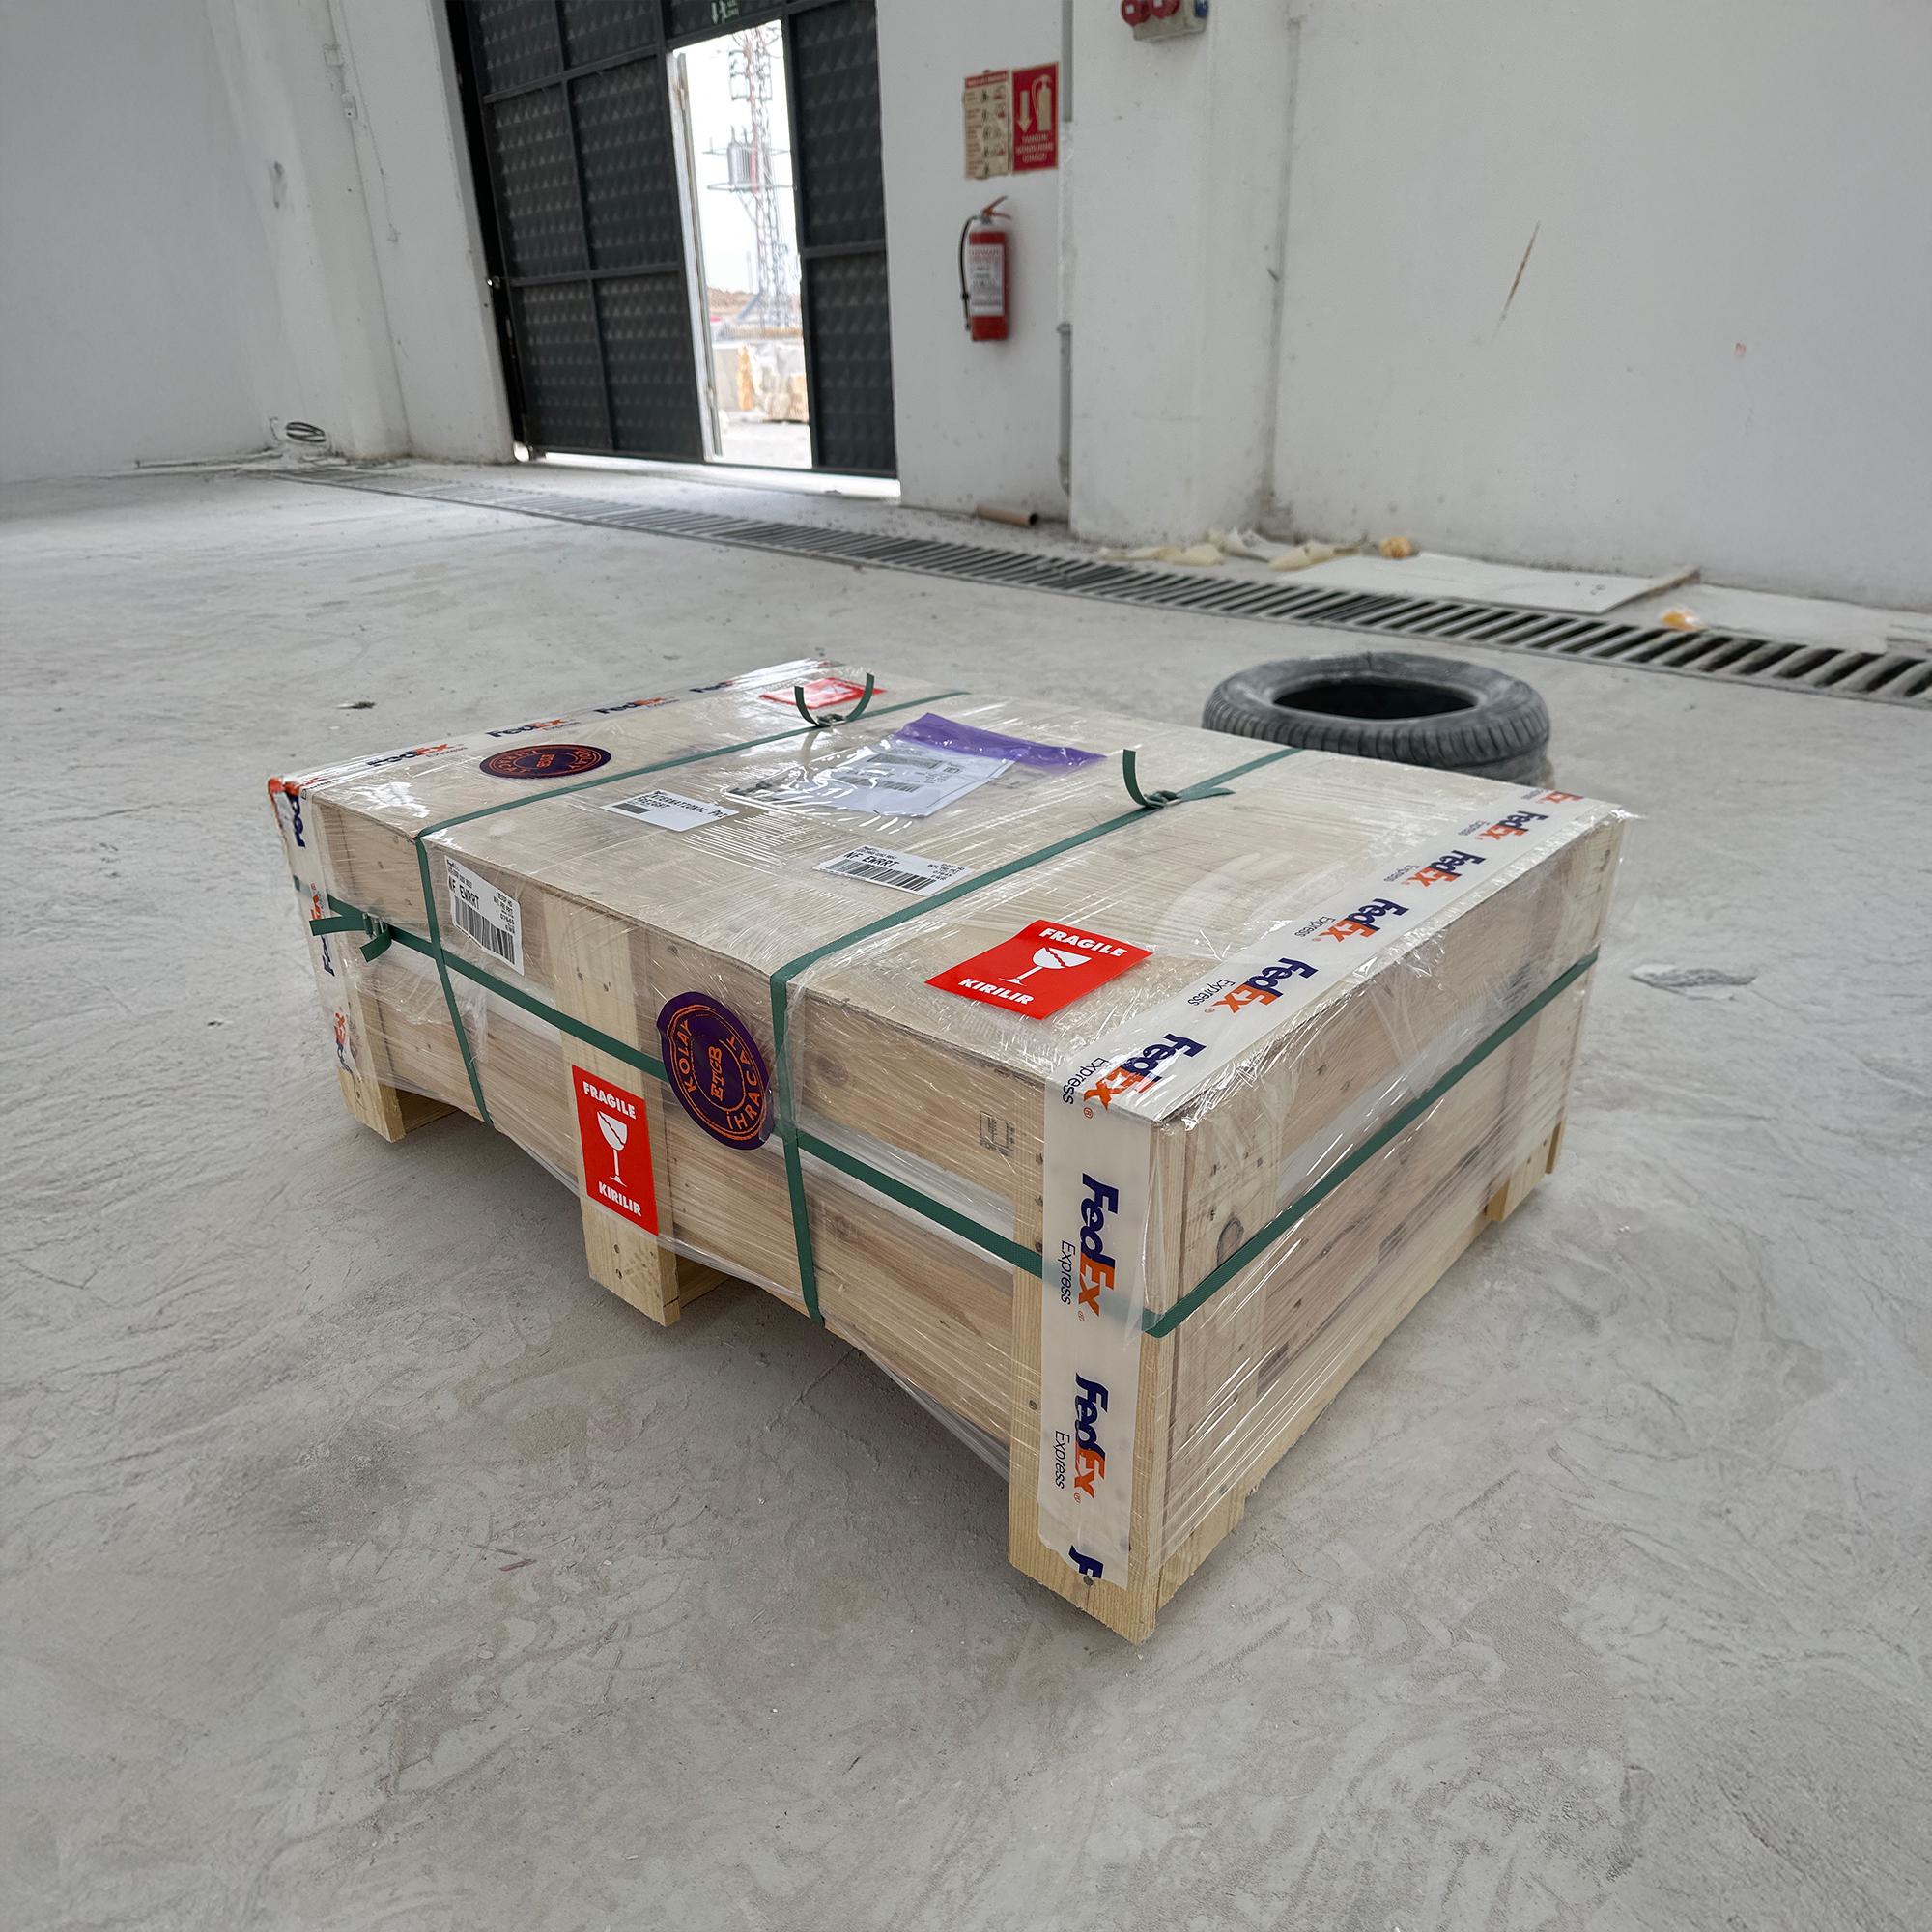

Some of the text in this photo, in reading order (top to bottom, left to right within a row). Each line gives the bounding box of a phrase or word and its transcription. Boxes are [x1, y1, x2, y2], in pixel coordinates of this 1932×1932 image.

[1479, 810, 1549, 840] FedEx
[1406, 849, 1487, 888] FedEx
[1037, 927, 1128, 957] FRAGILE
[1294, 916, 1336, 937] Express
[1317, 898, 1410, 943] FedEx
[957, 978, 1035, 1006] KIRILIR
[1187, 979, 1236, 1007] Express
[1212, 957, 1319, 1013] FedEx
[676, 1019, 697, 1094] KOLAY
[708, 1046, 724, 1102] ETGB
[1083, 1033, 1207, 1110] FedEx
[582, 1081, 637, 1120] FRAGILE
[725, 1035, 761, 1130] İHRACAT
[1063, 1057, 1110, 1105] Express
[598, 1181, 642, 1218] KIRILIR
[1078, 1173, 1119, 1317] FedEx
[1058, 1240, 1076, 1305] Express
[1074, 1372, 1109, 1499] FedEx
[1055, 1430, 1070, 1490] Express
